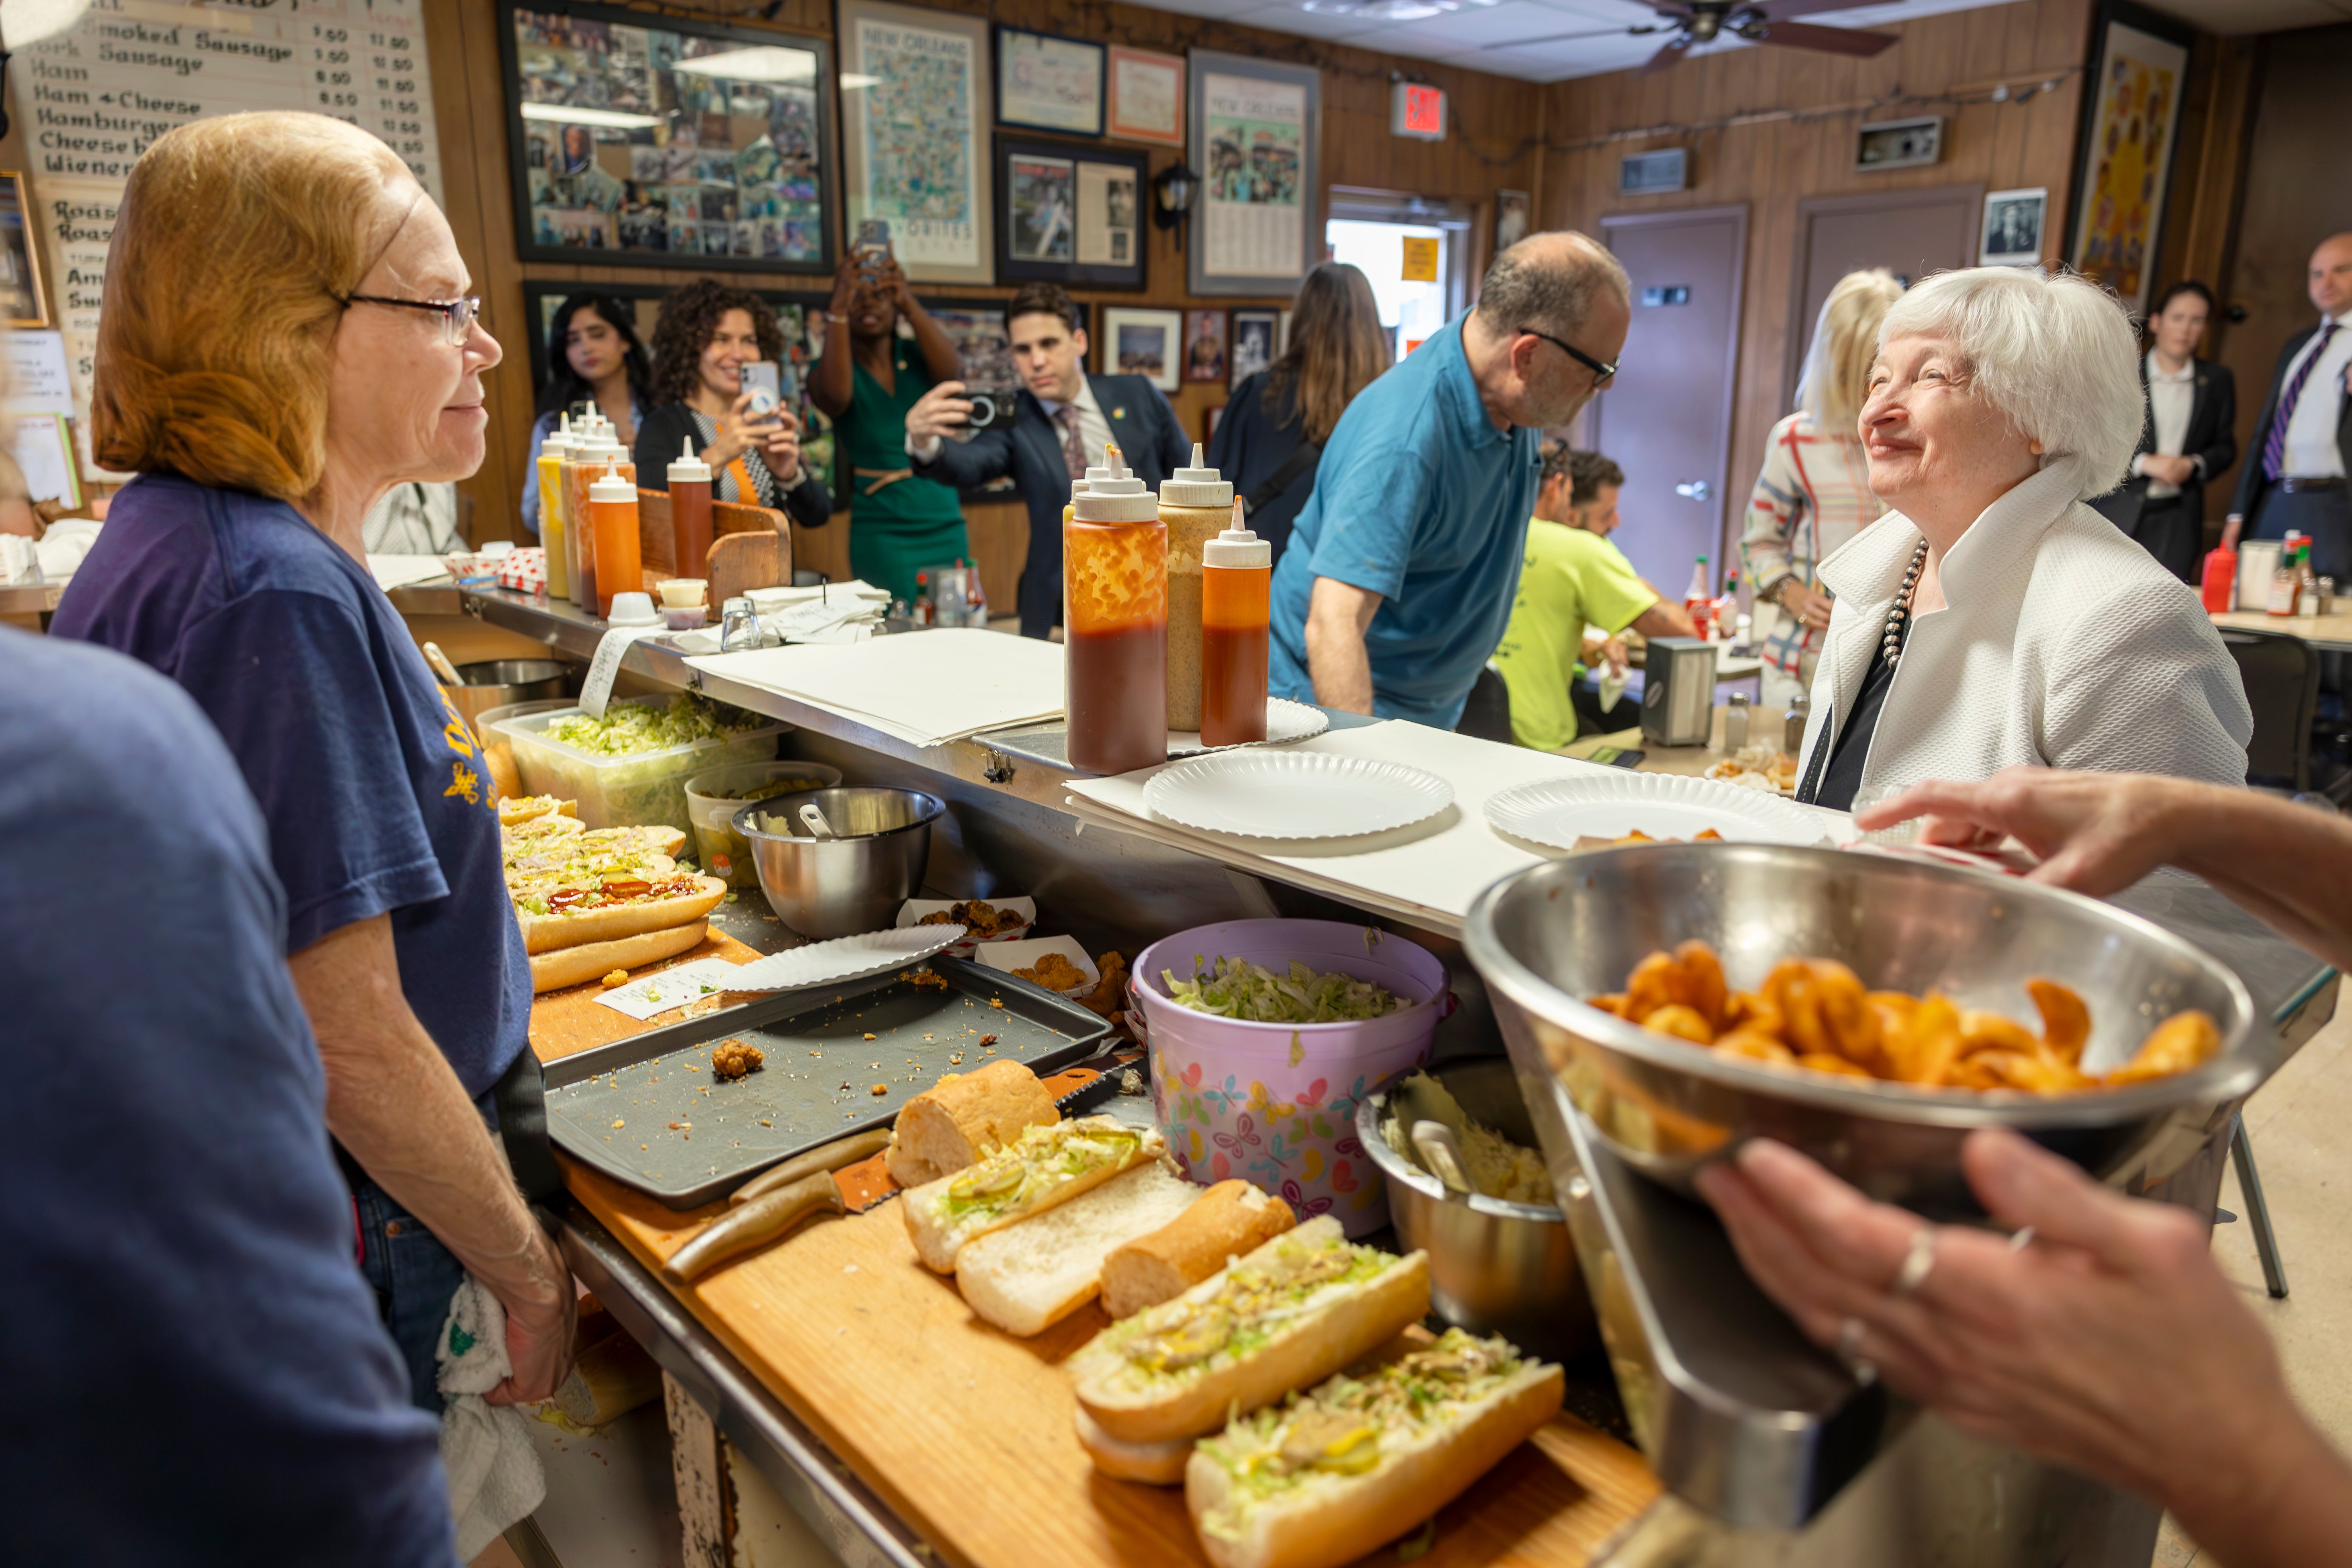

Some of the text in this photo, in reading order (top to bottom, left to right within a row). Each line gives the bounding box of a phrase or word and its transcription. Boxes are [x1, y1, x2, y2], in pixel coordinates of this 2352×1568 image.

[99, 42, 202, 76] Sausage
[196, 30, 292, 62] Sausage
[31, 58, 89, 81] Ham
[34, 83, 89, 105] Ham
[119, 90, 201, 115] Cheese
[52, 201, 117, 223] Roas
[53, 224, 113, 243] Roas
